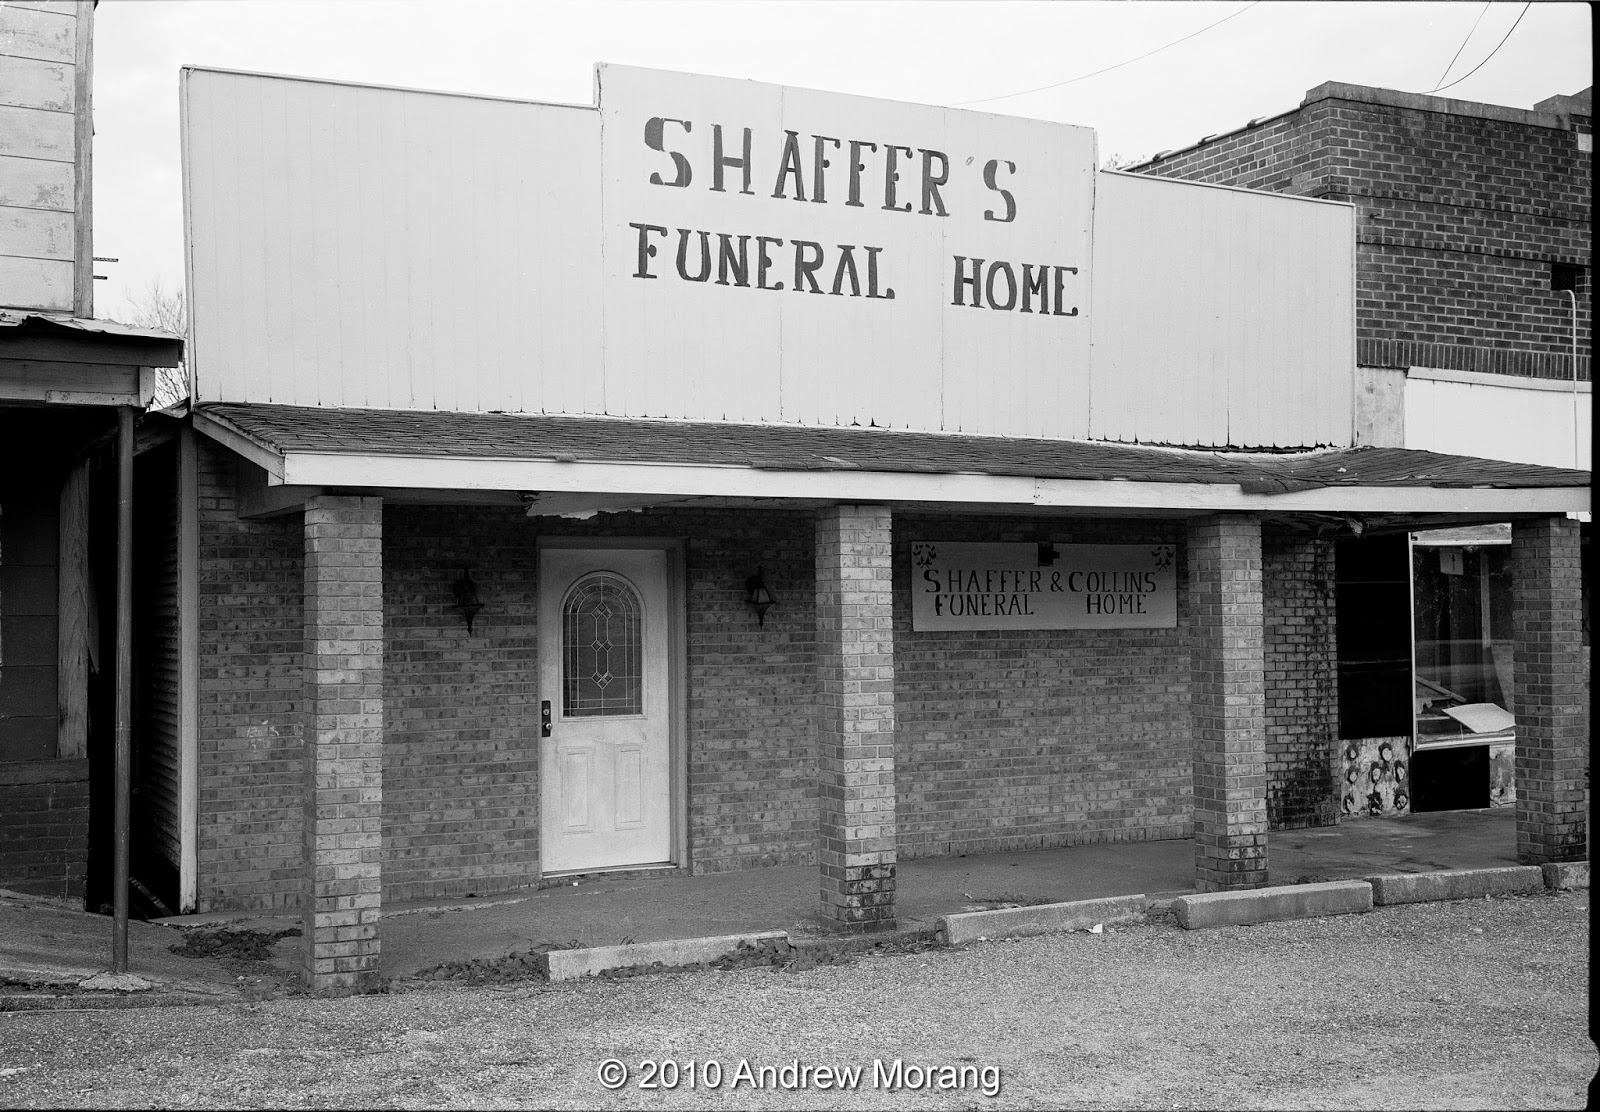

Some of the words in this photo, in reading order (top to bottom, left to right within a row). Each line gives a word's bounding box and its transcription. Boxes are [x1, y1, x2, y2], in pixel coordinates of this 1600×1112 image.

[629, 222, 895, 300] FUNERAL
[951, 255, 1079, 317] HOME
[923, 569, 1043, 593] SHAFFER
[1050, 572, 1064, 593] &
[1068, 571, 1157, 593] COLLINS
[935, 594, 1034, 617] FUNERAL
[1086, 594, 1147, 615] HOME
